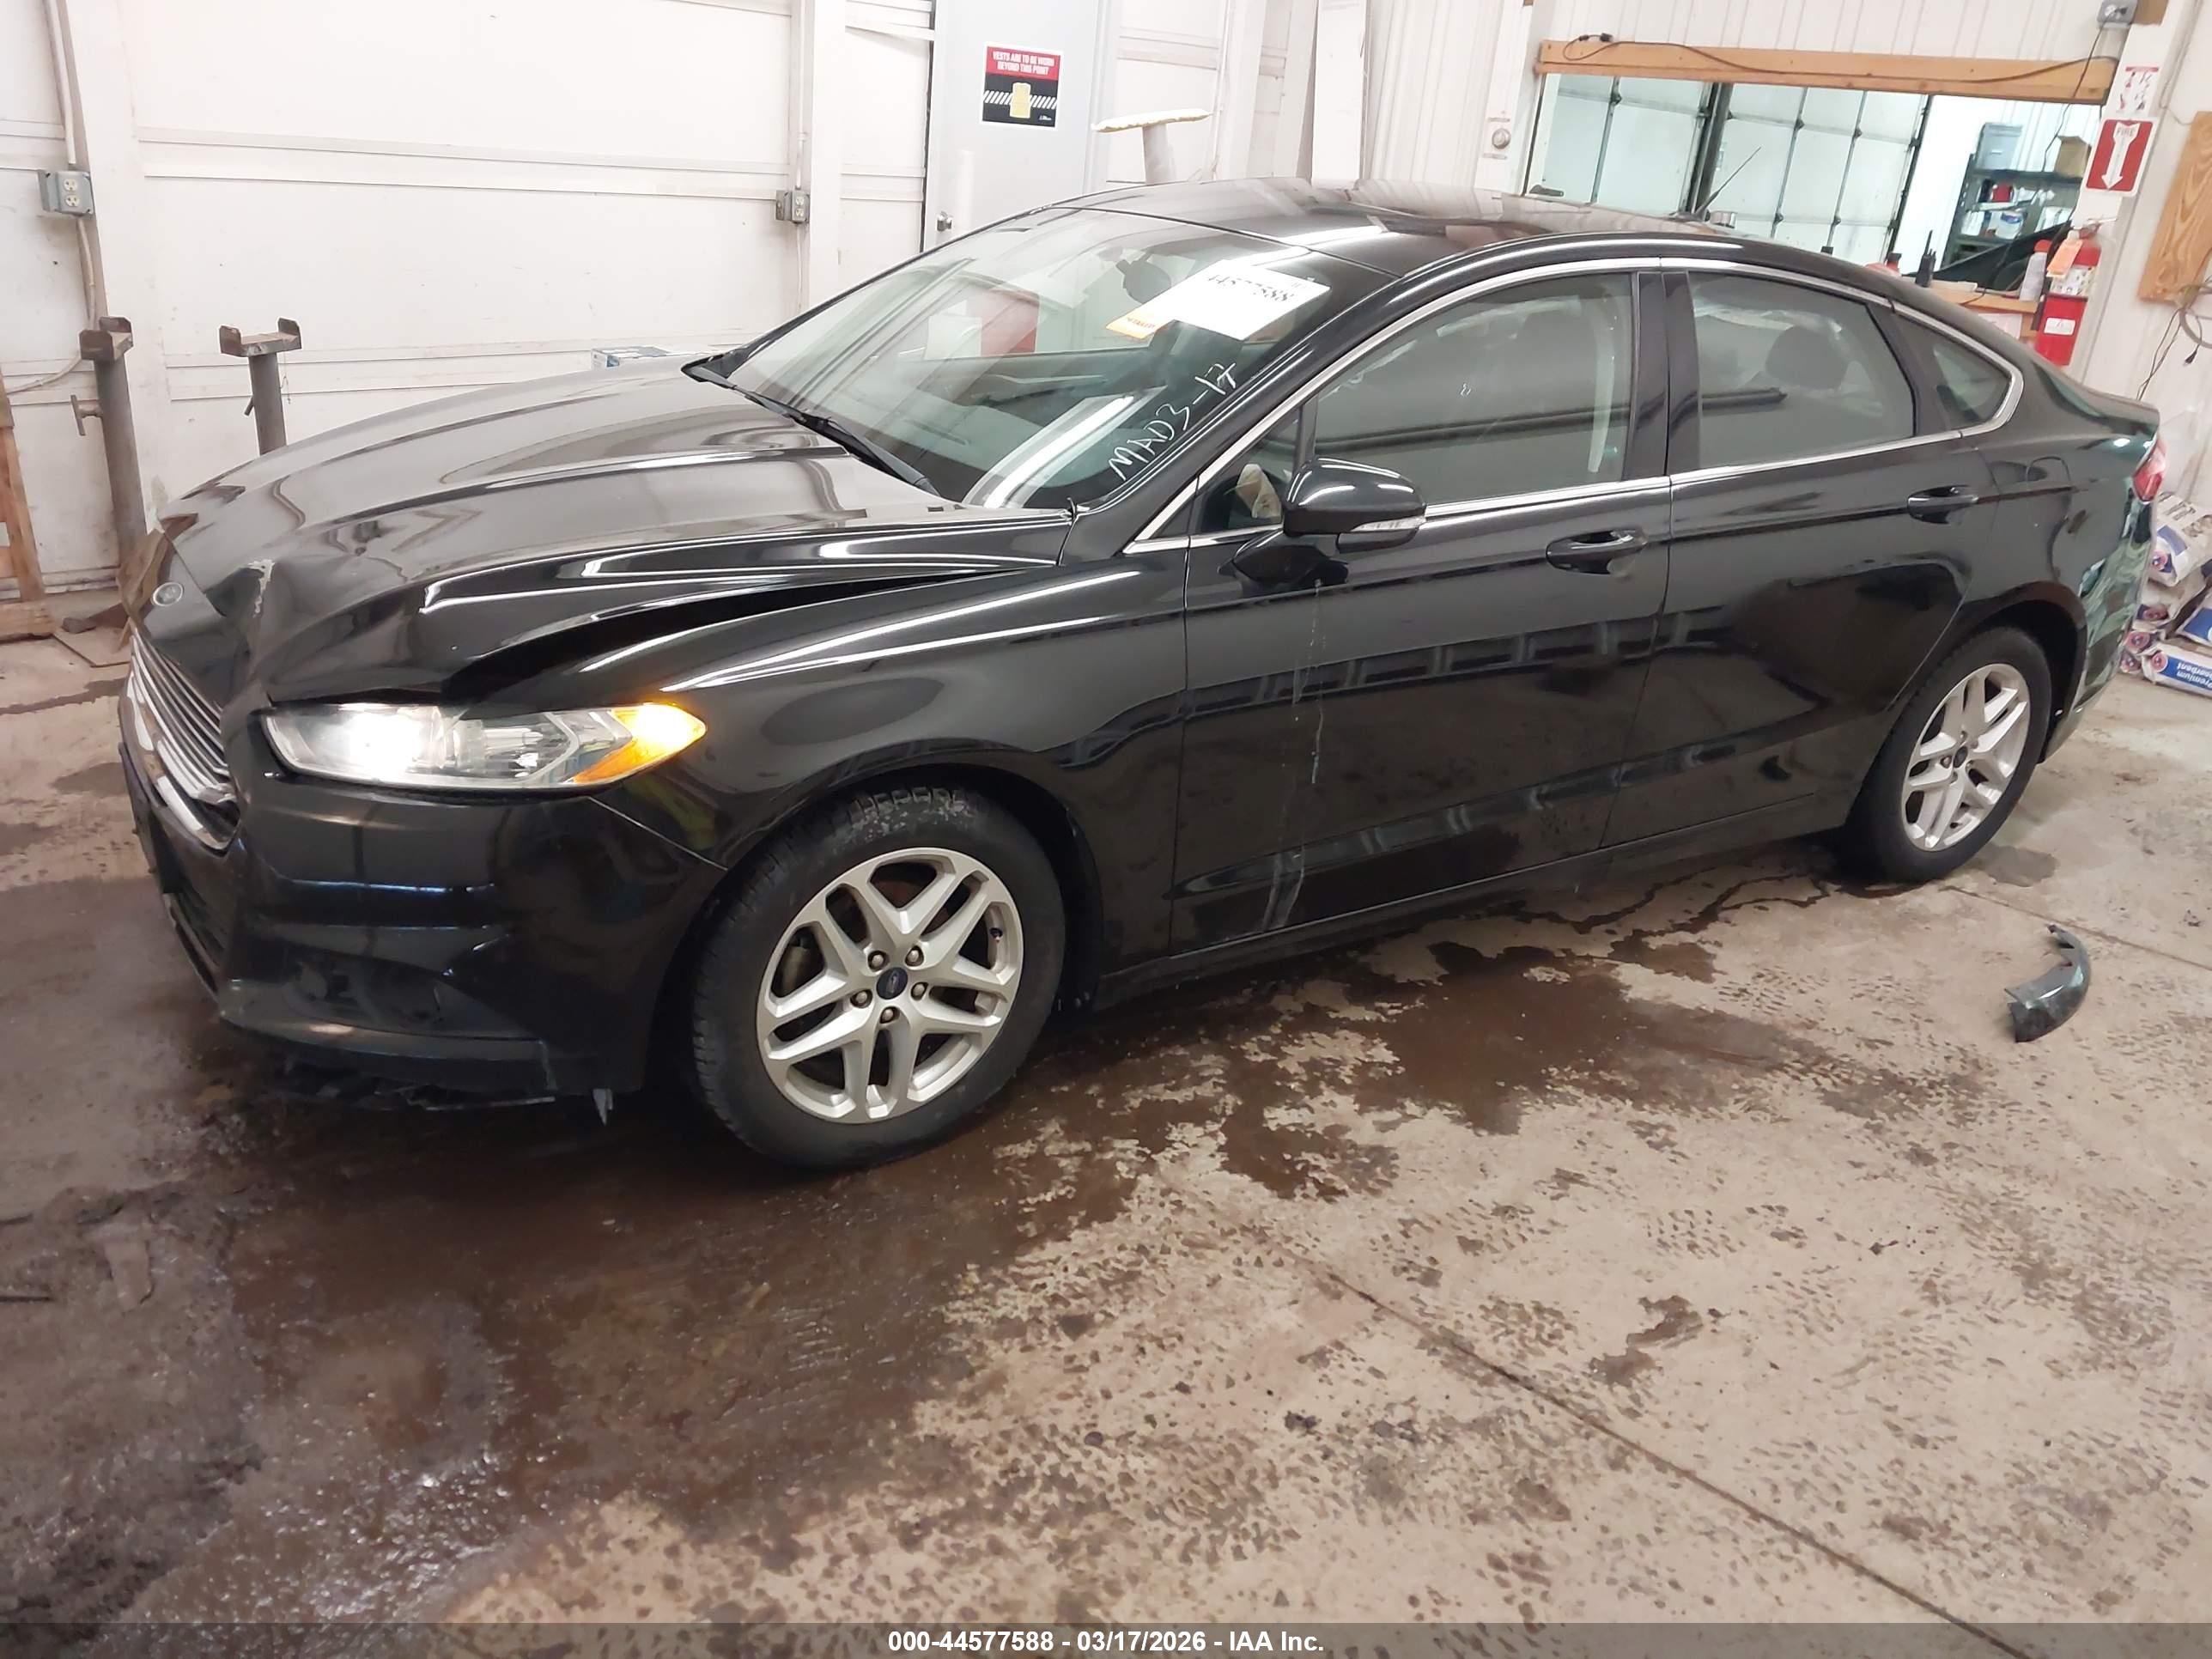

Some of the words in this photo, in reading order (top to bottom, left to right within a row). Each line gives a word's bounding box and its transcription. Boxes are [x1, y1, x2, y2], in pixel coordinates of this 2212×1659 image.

[993, 52, 1010, 61] VESTS
[1010, 53, 1022, 63] ARE
[1022, 55, 1030, 64] TO
[1030, 56, 1037, 64] BE
[997, 62, 1019, 70] BEYOND
[1019, 64, 1032, 73] THIS
[1033, 65, 1049, 76] POINT
[2117, 126, 2136, 137] FIRE
